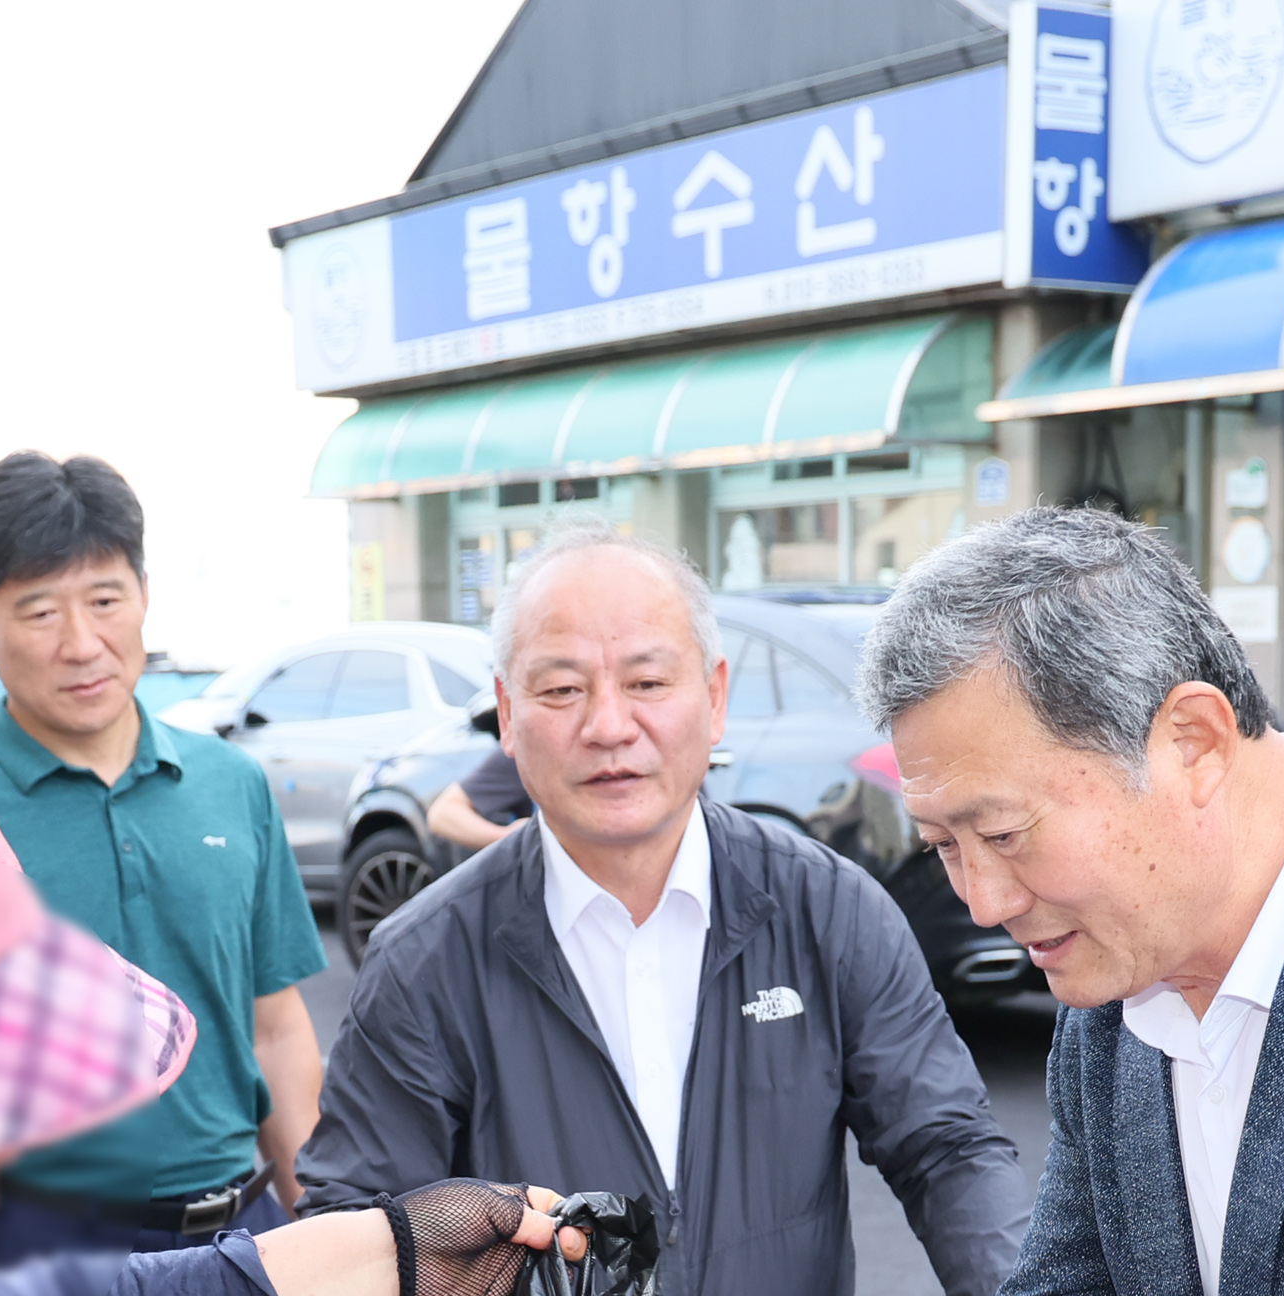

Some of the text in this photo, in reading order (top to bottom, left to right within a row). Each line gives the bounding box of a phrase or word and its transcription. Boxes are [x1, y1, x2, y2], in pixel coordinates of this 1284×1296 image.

[1033, 32, 1108, 258] 물항
[463, 105, 886, 322] 물항수산
[757, 987, 782, 1001] THE
[741, 998, 783, 1017] NORTH
[755, 1006, 787, 1023] FACE
